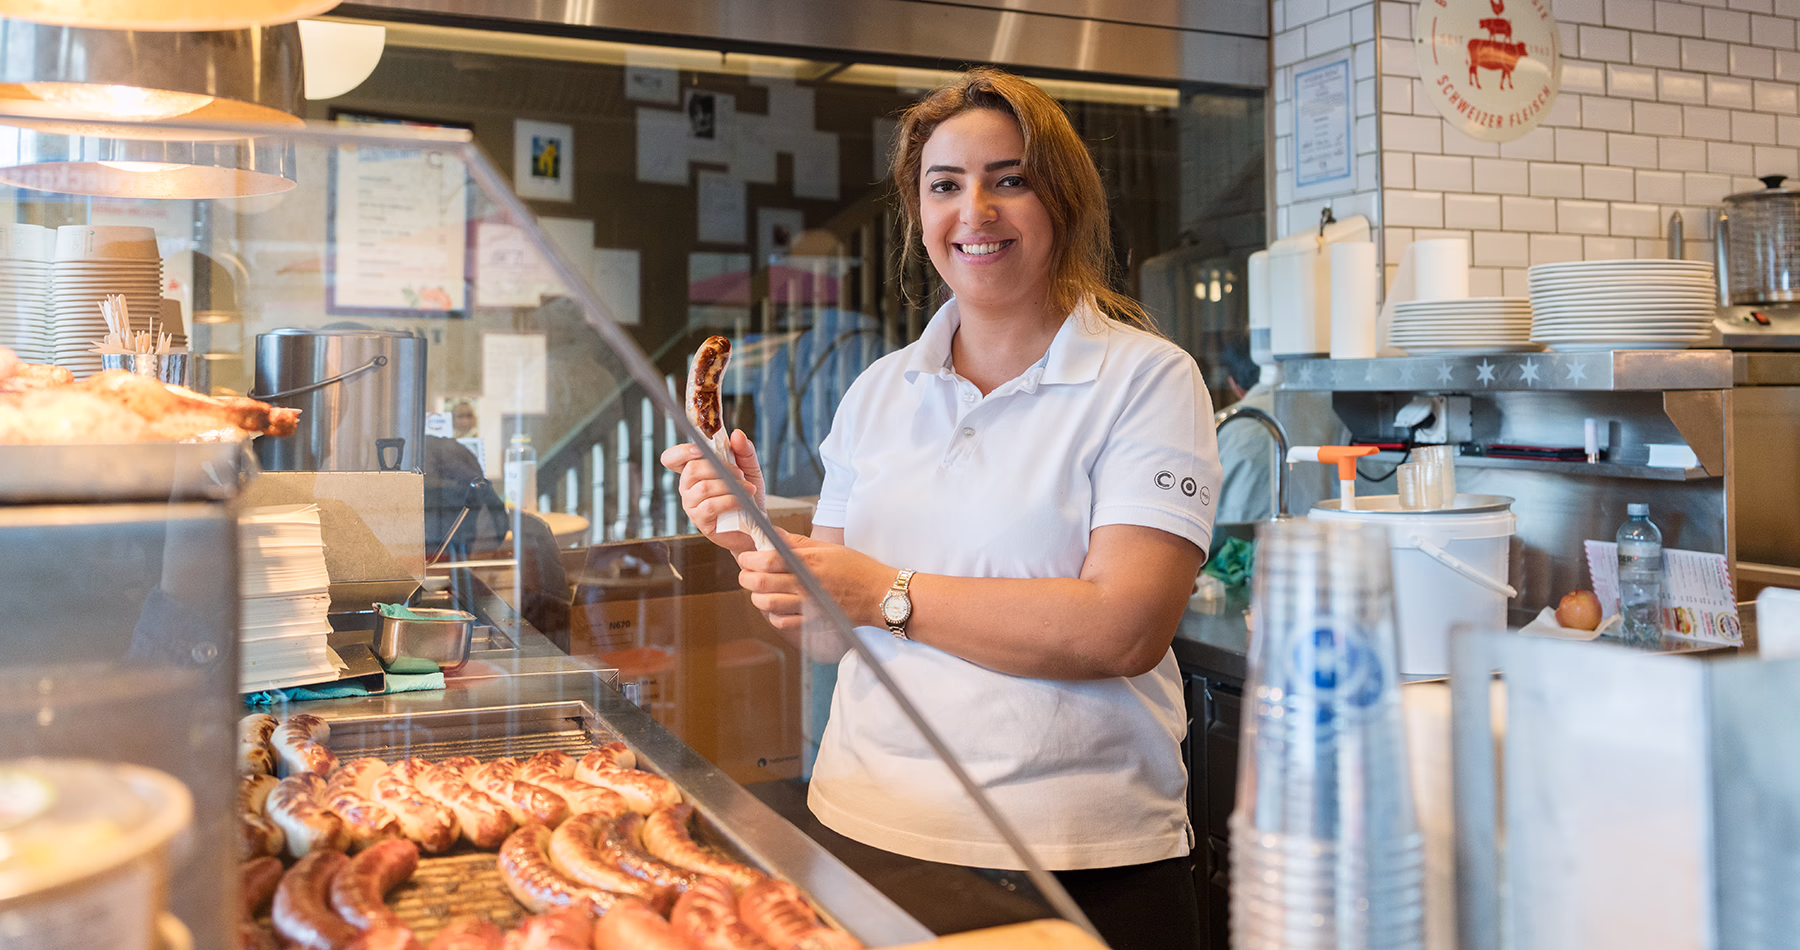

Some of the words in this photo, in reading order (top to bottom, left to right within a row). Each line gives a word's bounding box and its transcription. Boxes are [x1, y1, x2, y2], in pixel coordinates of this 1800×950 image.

[1437, 75, 1504, 129] SCHWEIZER
[1509, 84, 1551, 128] FLEISCH
[609, 620, 631, 630] N670
